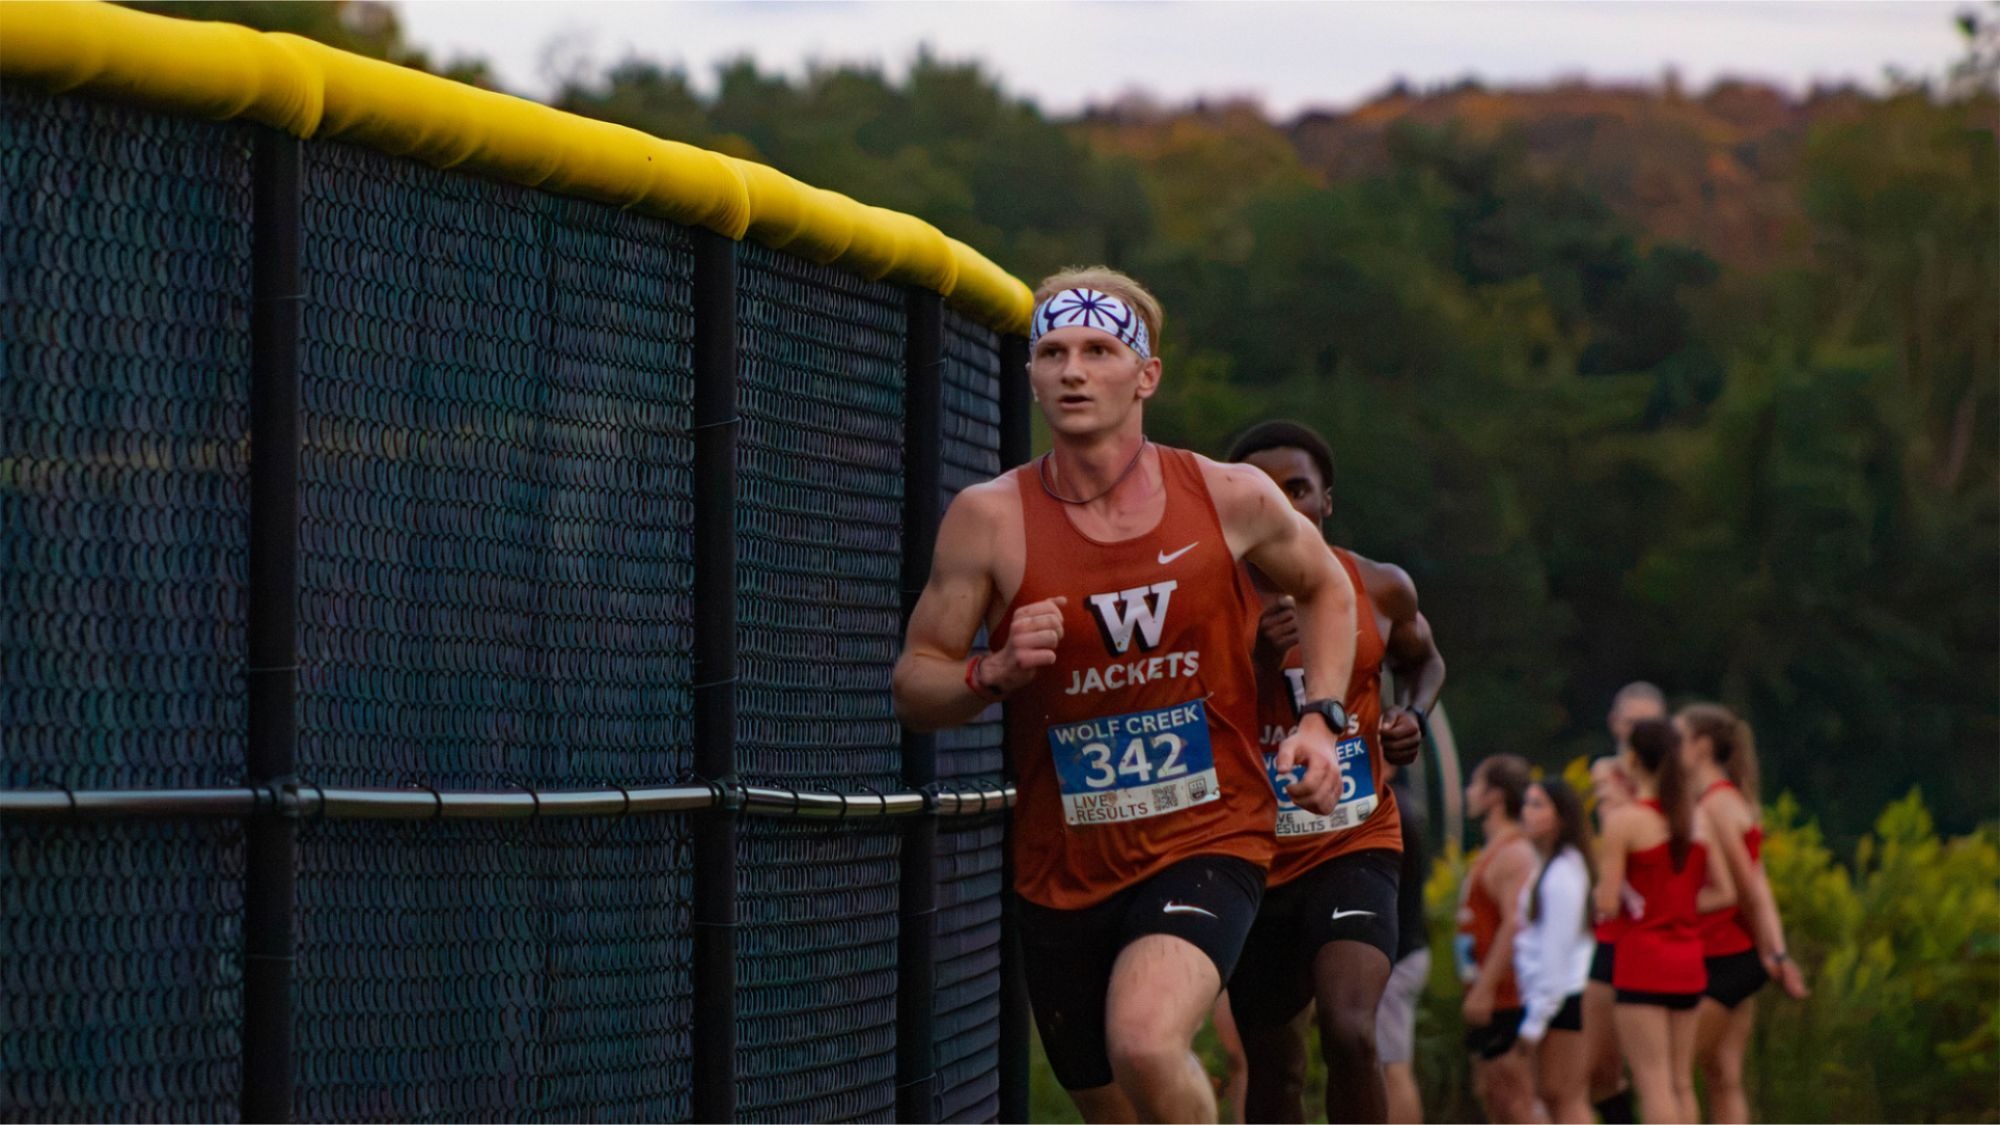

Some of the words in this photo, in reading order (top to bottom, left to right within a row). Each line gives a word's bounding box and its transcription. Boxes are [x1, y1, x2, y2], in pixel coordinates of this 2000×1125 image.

[1087, 580, 1178, 655] W
[1065, 651, 1200, 696] JACKETS
[1055, 719, 1120, 745] WOLF
[1126, 704, 1199, 735] CREEK
[1082, 732, 1188, 788] 342
[1336, 740, 1365, 761] EEK
[1073, 793, 1107, 808] LIVE
[1275, 761, 1357, 807] 35
[1077, 802, 1149, 822] RESULTS
[1276, 820, 1326, 834] ESULTS
